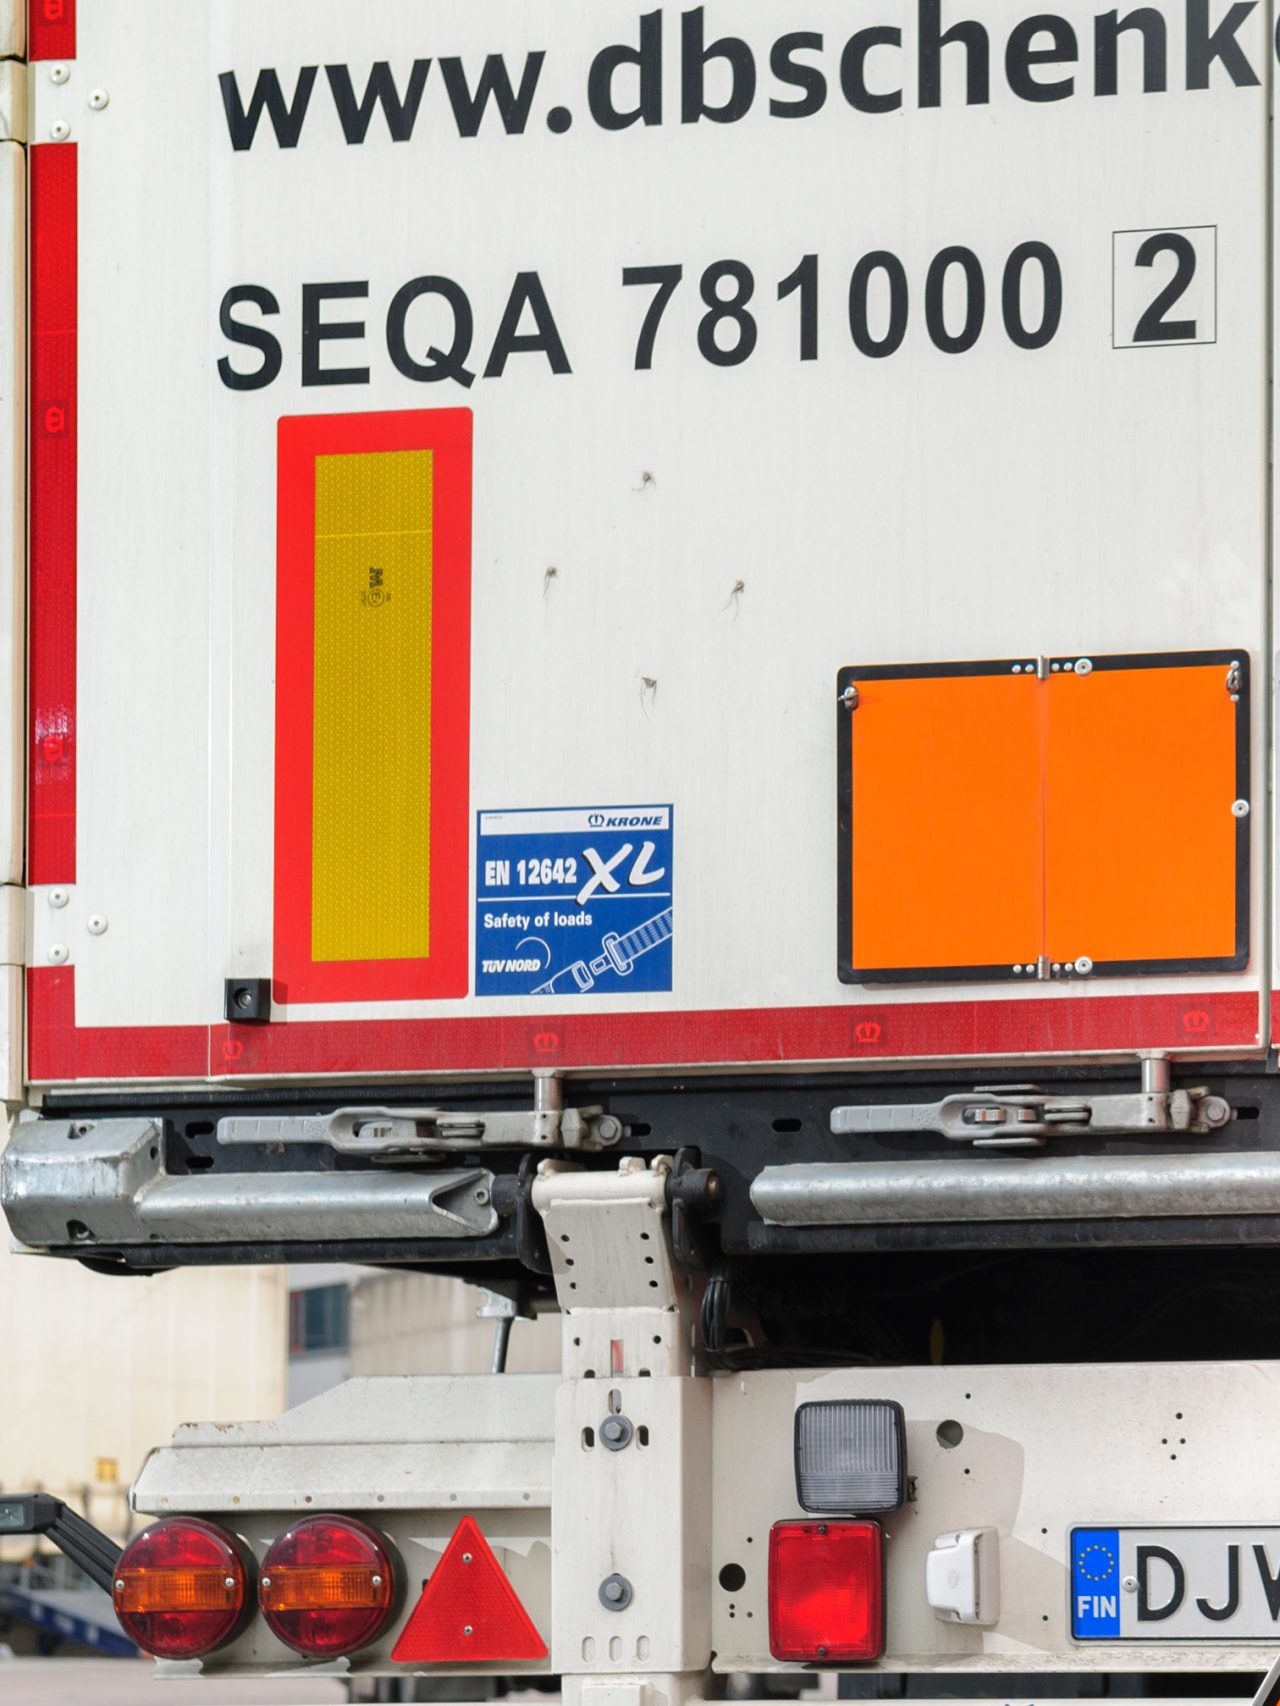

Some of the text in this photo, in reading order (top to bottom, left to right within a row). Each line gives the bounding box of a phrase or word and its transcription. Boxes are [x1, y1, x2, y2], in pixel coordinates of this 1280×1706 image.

[217, 233, 1197, 391] SEQA 781000 2
[606, 815, 663, 828] KRONE
[485, 841, 665, 906] EN 12642 XL
[484, 911, 593, 931] Safety of loads
[1077, 1595, 1117, 1618] FIN
